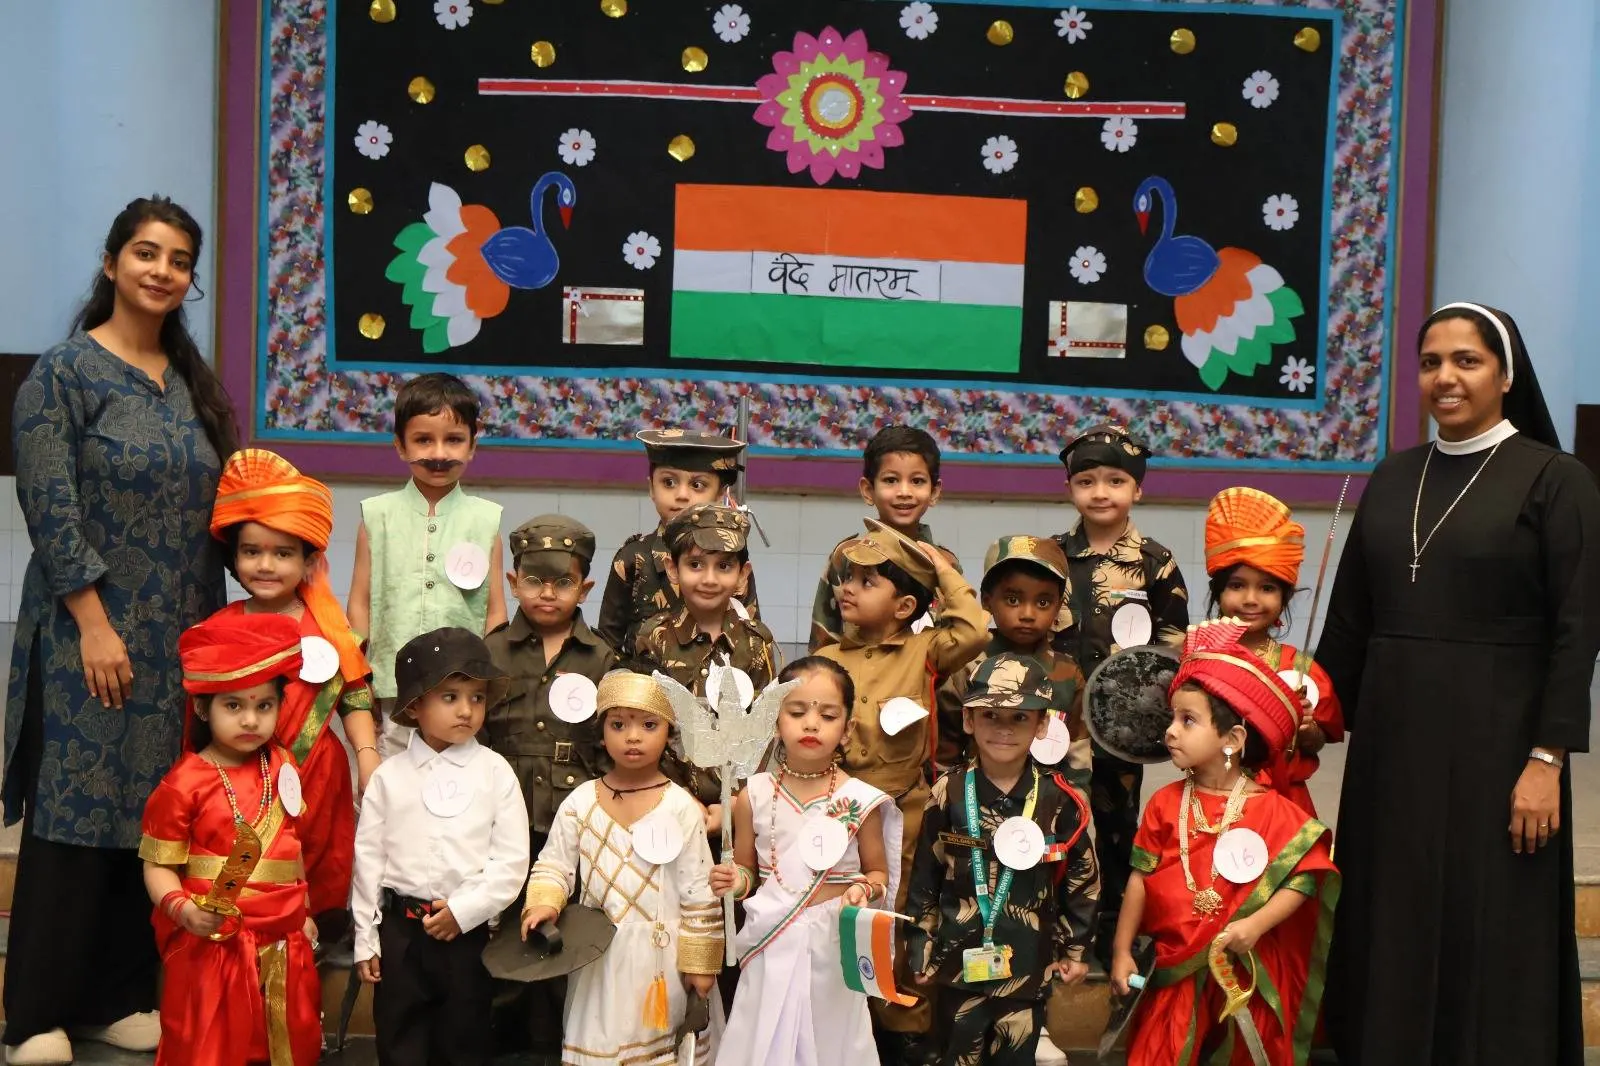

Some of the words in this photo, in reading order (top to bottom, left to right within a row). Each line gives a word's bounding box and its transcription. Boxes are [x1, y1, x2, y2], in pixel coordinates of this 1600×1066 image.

[768, 253, 814, 294] वंदे
[454, 556, 474, 577] 10
[567, 687, 584, 712] 6
[435, 778, 465, 802] 12
[967, 782, 975, 804] SCHOOL
[969, 806, 978, 832] CONVENT
[651, 828, 669, 849] 11
[811, 835, 823, 857] 9
[1010, 829, 1032, 854] 3
[973, 850, 981, 862] AND
[1230, 847, 1256, 870] 16
[975, 863, 984, 882] JESUS
